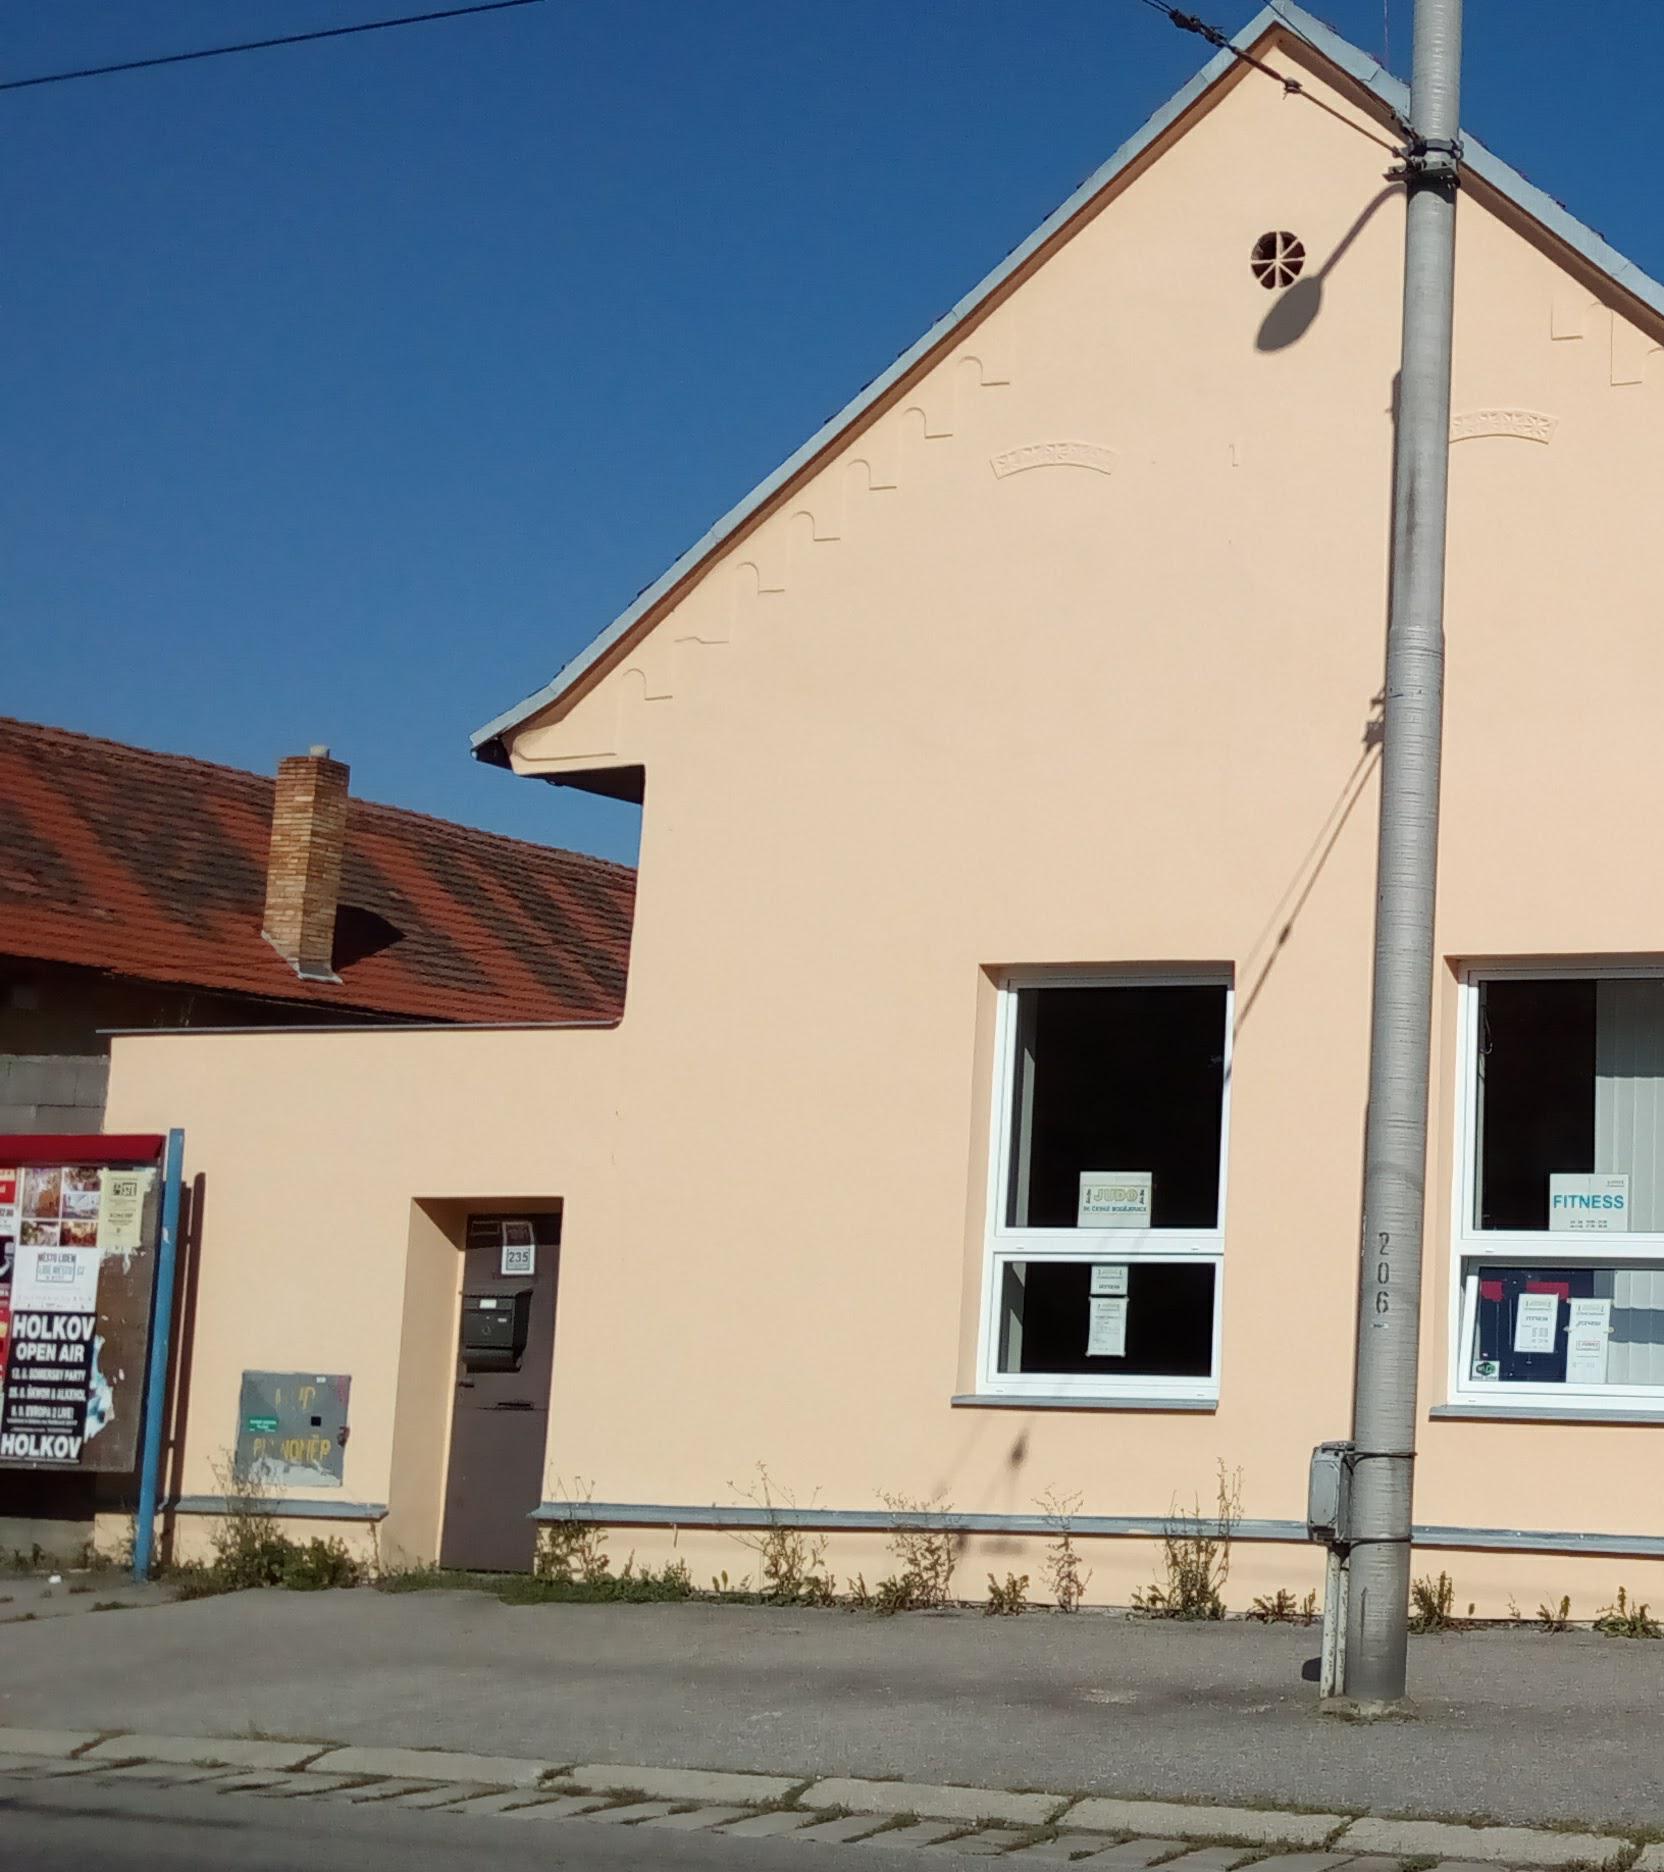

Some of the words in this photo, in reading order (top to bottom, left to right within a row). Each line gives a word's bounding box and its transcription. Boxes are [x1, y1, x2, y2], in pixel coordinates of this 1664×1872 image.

[1093, 1188, 1138, 1202] JUDO
[1553, 1194, 1624, 1209] FITNESS
[508, 1251, 529, 1263] 235
[1375, 1231, 1390, 1314] 206
[12, 1314, 96, 1341] HOLKOV
[16, 1343, 57, 1362] OPEN
[59, 1344, 85, 1362] AIR
[1, 1433, 82, 1459] HOLKOV
